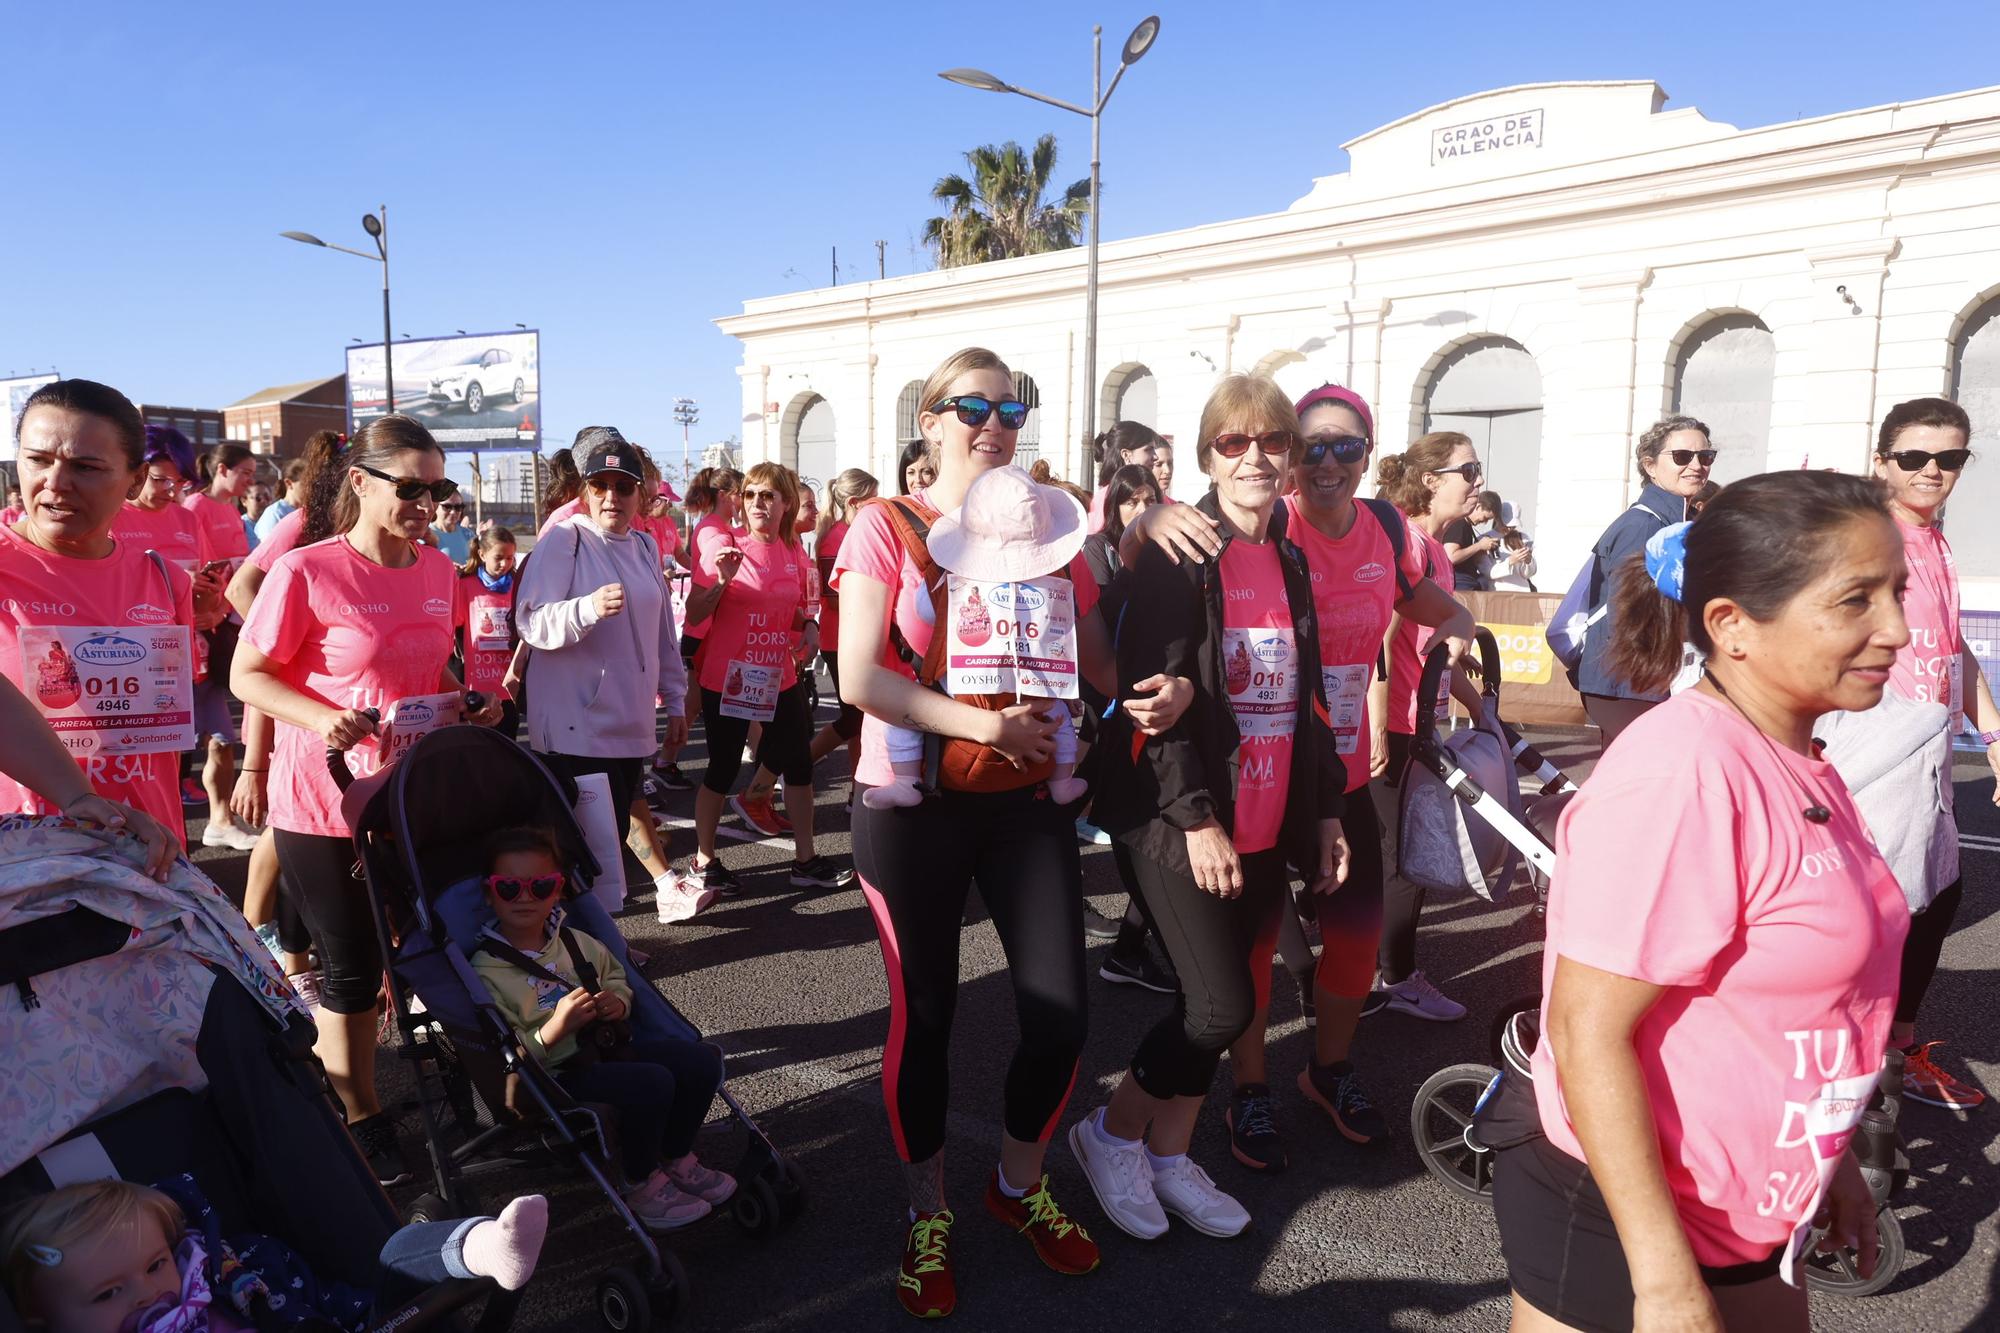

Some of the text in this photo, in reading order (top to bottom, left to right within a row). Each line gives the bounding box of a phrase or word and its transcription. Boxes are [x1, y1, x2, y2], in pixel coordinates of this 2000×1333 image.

[1442, 116, 1532, 143] GRAO DE
[1438, 131, 1534, 159] VALENCIA
[993, 591, 1040, 605] ASTRIANA
[1048, 593, 1067, 602] SUMA
[2, 599, 76, 617] OYSHO
[340, 603, 389, 616] OYSHO
[749, 613, 767, 627] TU
[996, 619, 1039, 638] 016
[1909, 628, 1937, 648] TU
[80, 646, 141, 659] ASTURIANA
[151, 641, 179, 650] SUMA
[1026, 661, 1050, 669] MUJER
[1500, 659, 1541, 674] .es
[85, 676, 140, 696] 016
[962, 675, 1003, 685] OYSHO
[1032, 677, 1069, 688] Santander
[1254, 672, 1284, 687] 016
[744, 685, 764, 696] 016
[1257, 690, 1278, 700] 4931
[349, 687, 383, 709] TU
[96, 700, 130, 711] 4946
[95, 718, 109, 727] DE
[110, 717, 122, 726] LA
[124, 717, 154, 726] MUJER
[157, 715, 178, 724] 2023
[134, 733, 182, 746] Santander
[1243, 754, 1274, 781] MA
[1784, 1029, 1847, 1080] TU
[372, 1306, 420, 1333] nglesina
